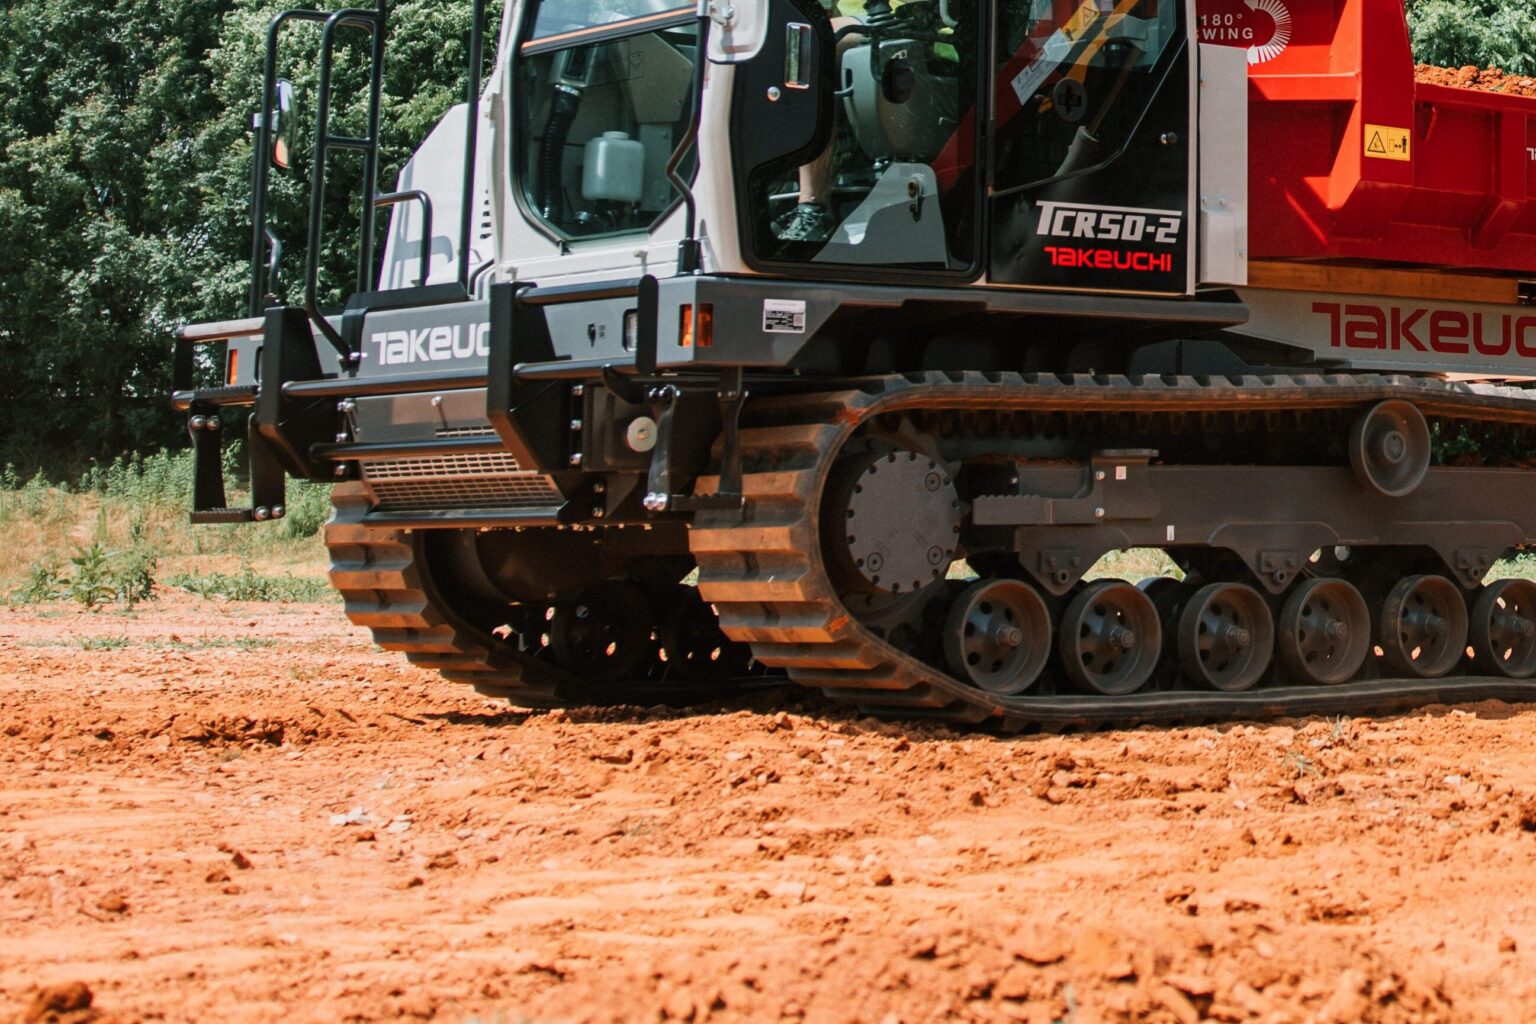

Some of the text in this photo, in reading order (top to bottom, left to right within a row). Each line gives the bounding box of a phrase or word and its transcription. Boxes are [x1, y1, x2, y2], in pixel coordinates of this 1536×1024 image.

[1196, 27, 1254, 41] WING
[1035, 200, 1183, 244] TCR50-2
[1043, 246, 1172, 272] TAKEUCHI
